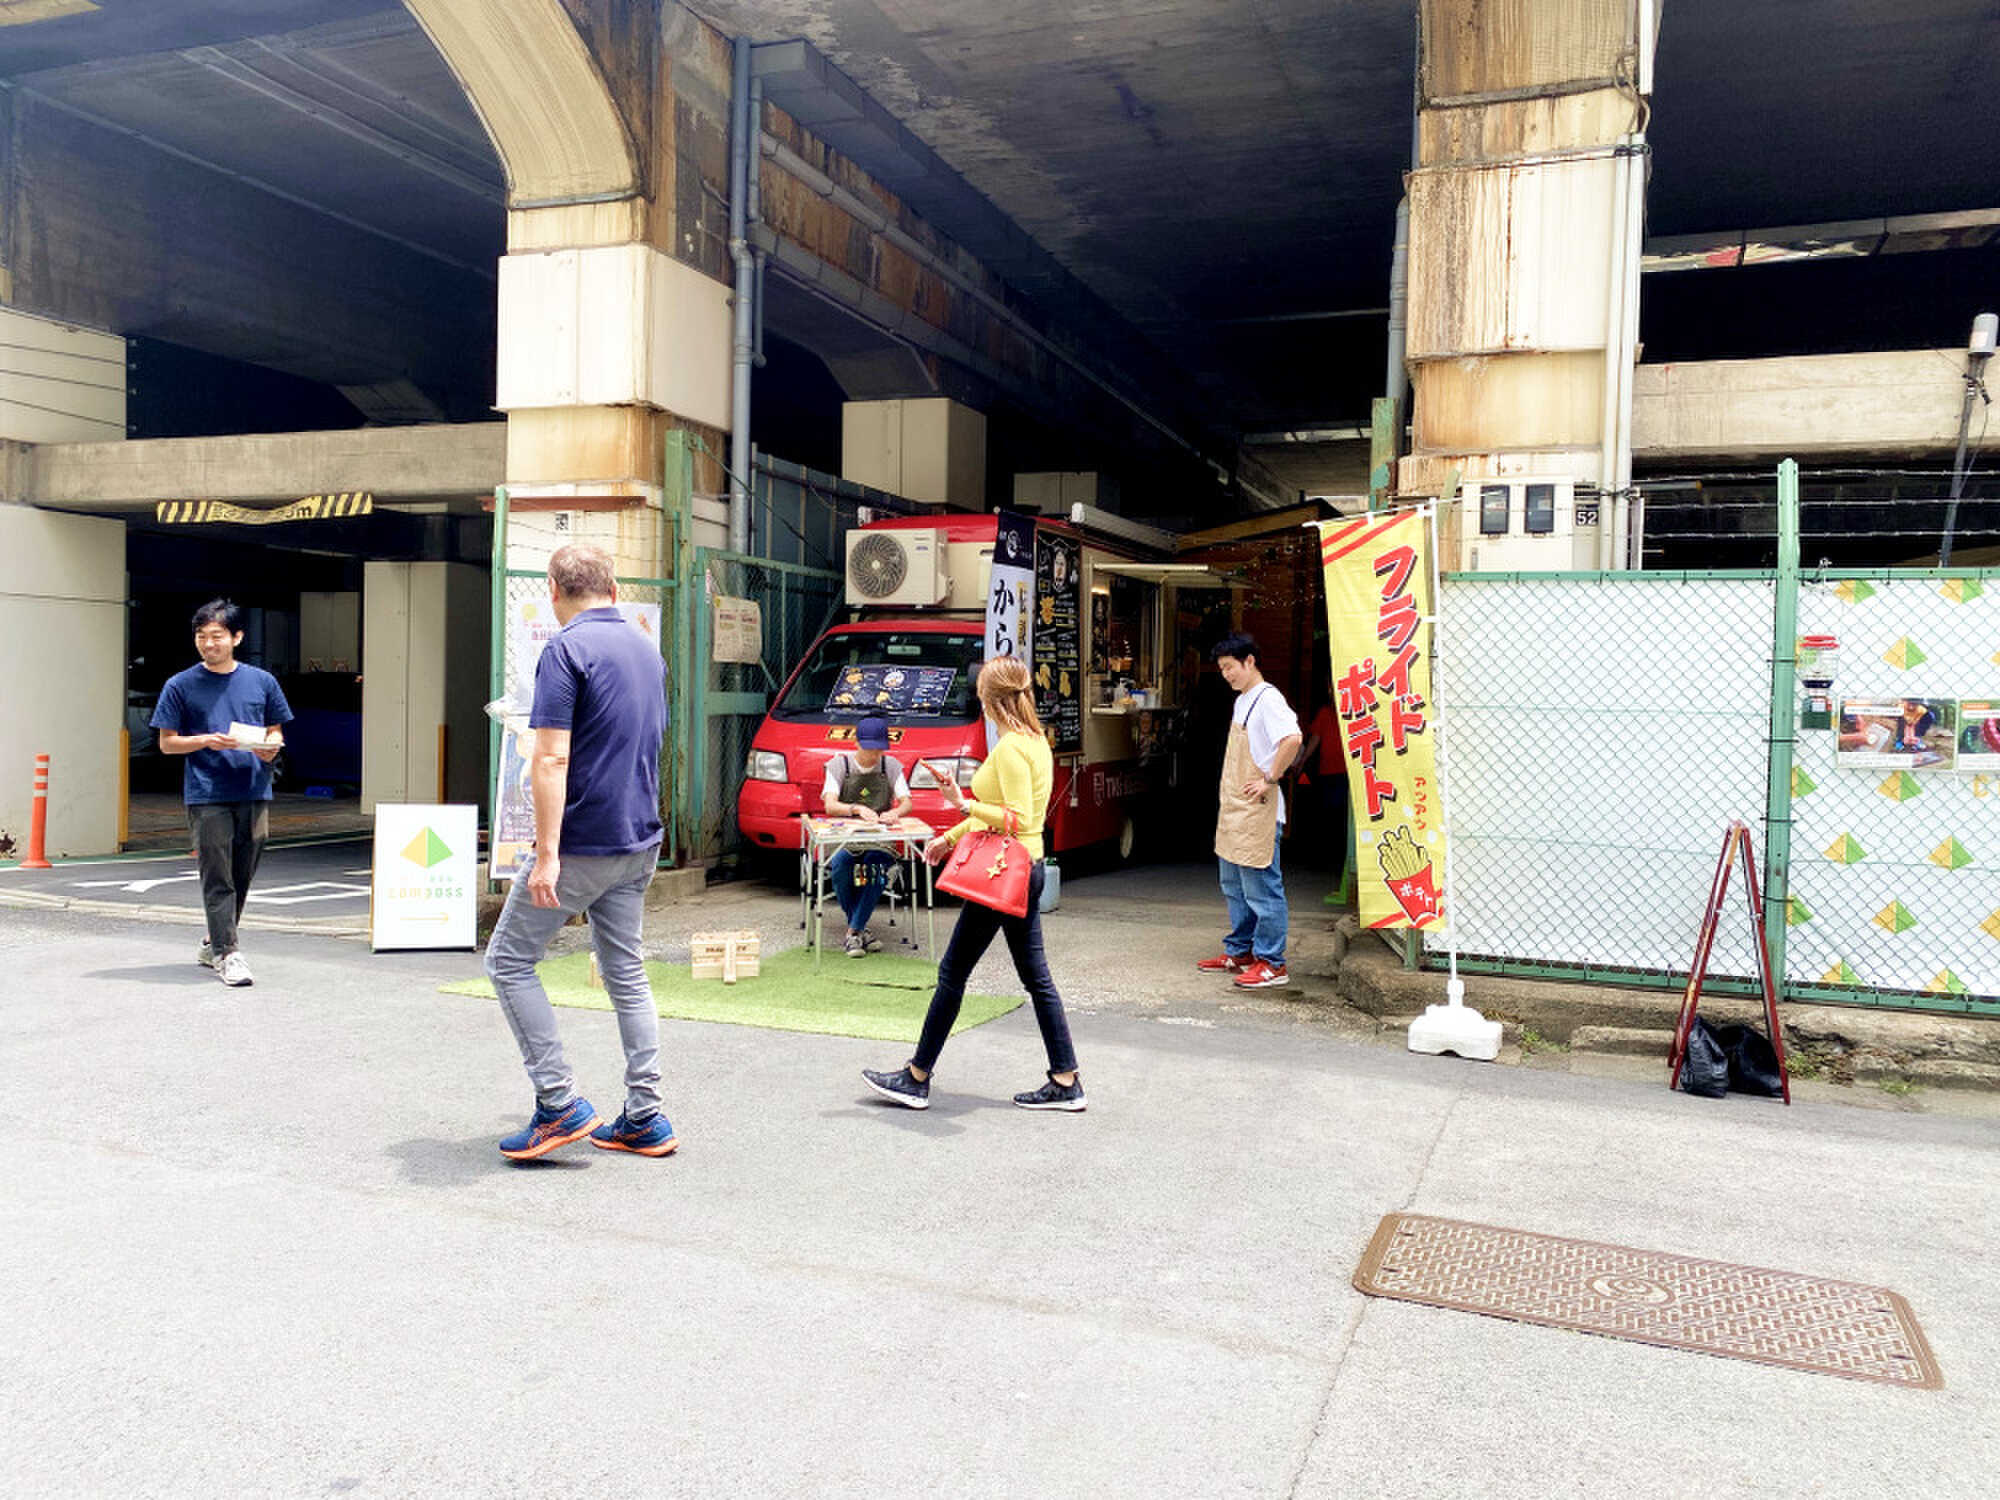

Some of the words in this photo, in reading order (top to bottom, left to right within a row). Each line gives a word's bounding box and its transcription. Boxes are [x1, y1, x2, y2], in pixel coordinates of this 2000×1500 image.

[1577, 510, 1598, 526] 52
[1373, 545, 1426, 756] フライド
[1337, 657, 1397, 822] ポテト
